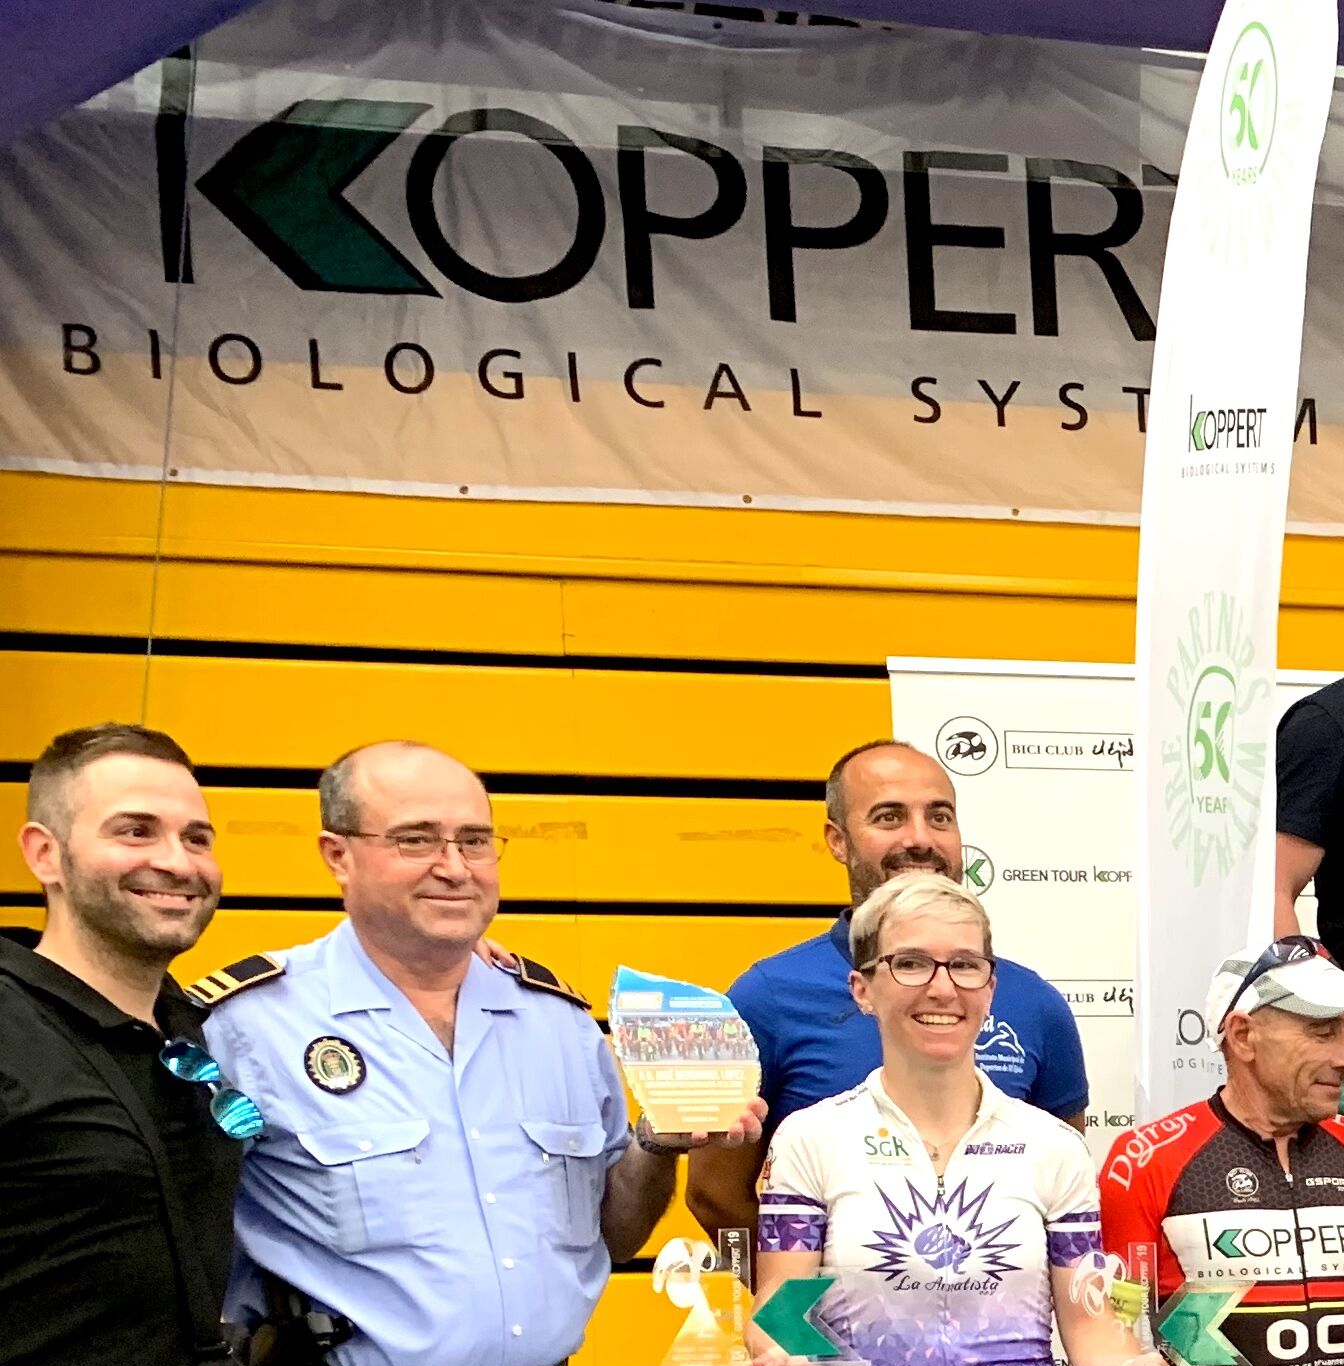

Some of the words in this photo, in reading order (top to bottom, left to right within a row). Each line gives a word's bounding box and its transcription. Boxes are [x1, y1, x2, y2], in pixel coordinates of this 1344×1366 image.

[156, 46, 1180, 342] KOPPER
[62, 323, 822, 419] BIOLOGICAL
[1190, 394, 1266, 452] KOPPERT
[1181, 463, 1229, 478] BIOLOGICAL
[1011, 743, 1043, 757] BICI
[1045, 744, 1084, 757] CLUB
[1002, 868, 1048, 883] GREEN
[1050, 868, 1088, 883] TOUR
[1093, 865, 1133, 883] KOPP
[864, 1135, 910, 1158] SGR
[1197, 1266, 1309, 1279] BIOLOGICAL
[893, 1274, 920, 1292] La
[925, 1274, 1000, 1293] Amatista
